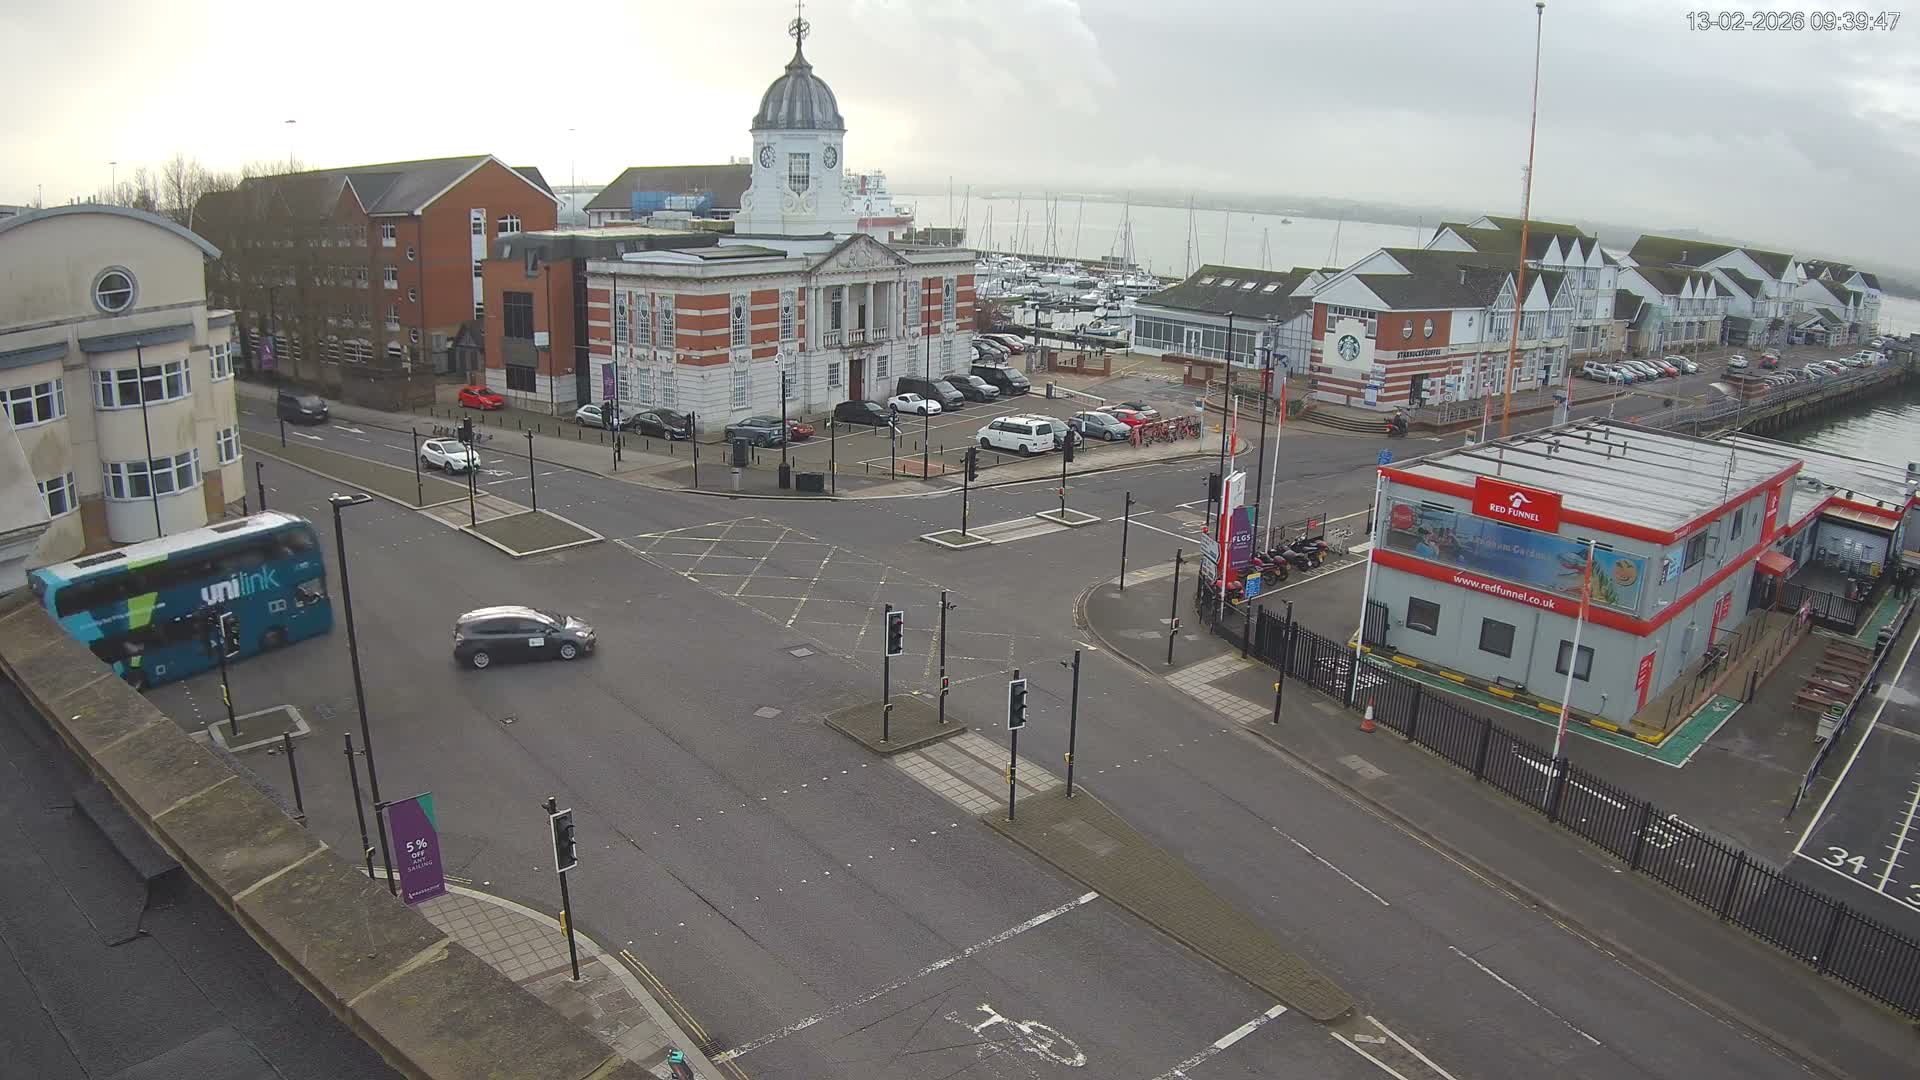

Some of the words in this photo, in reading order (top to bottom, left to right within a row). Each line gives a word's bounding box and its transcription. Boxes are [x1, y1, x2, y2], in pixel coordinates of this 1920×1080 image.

[1489, 503, 1506, 513] RED
[1507, 507, 1540, 522] FUNNEL
[200, 566, 281, 606] unilink
[1453, 575, 1556, 609] www.redfunnel.co.uk
[411, 850, 425, 859] OFF
[413, 856, 426, 865] ANY
[1822, 846, 1868, 875] 34
[407, 860, 433, 872] SAILING
